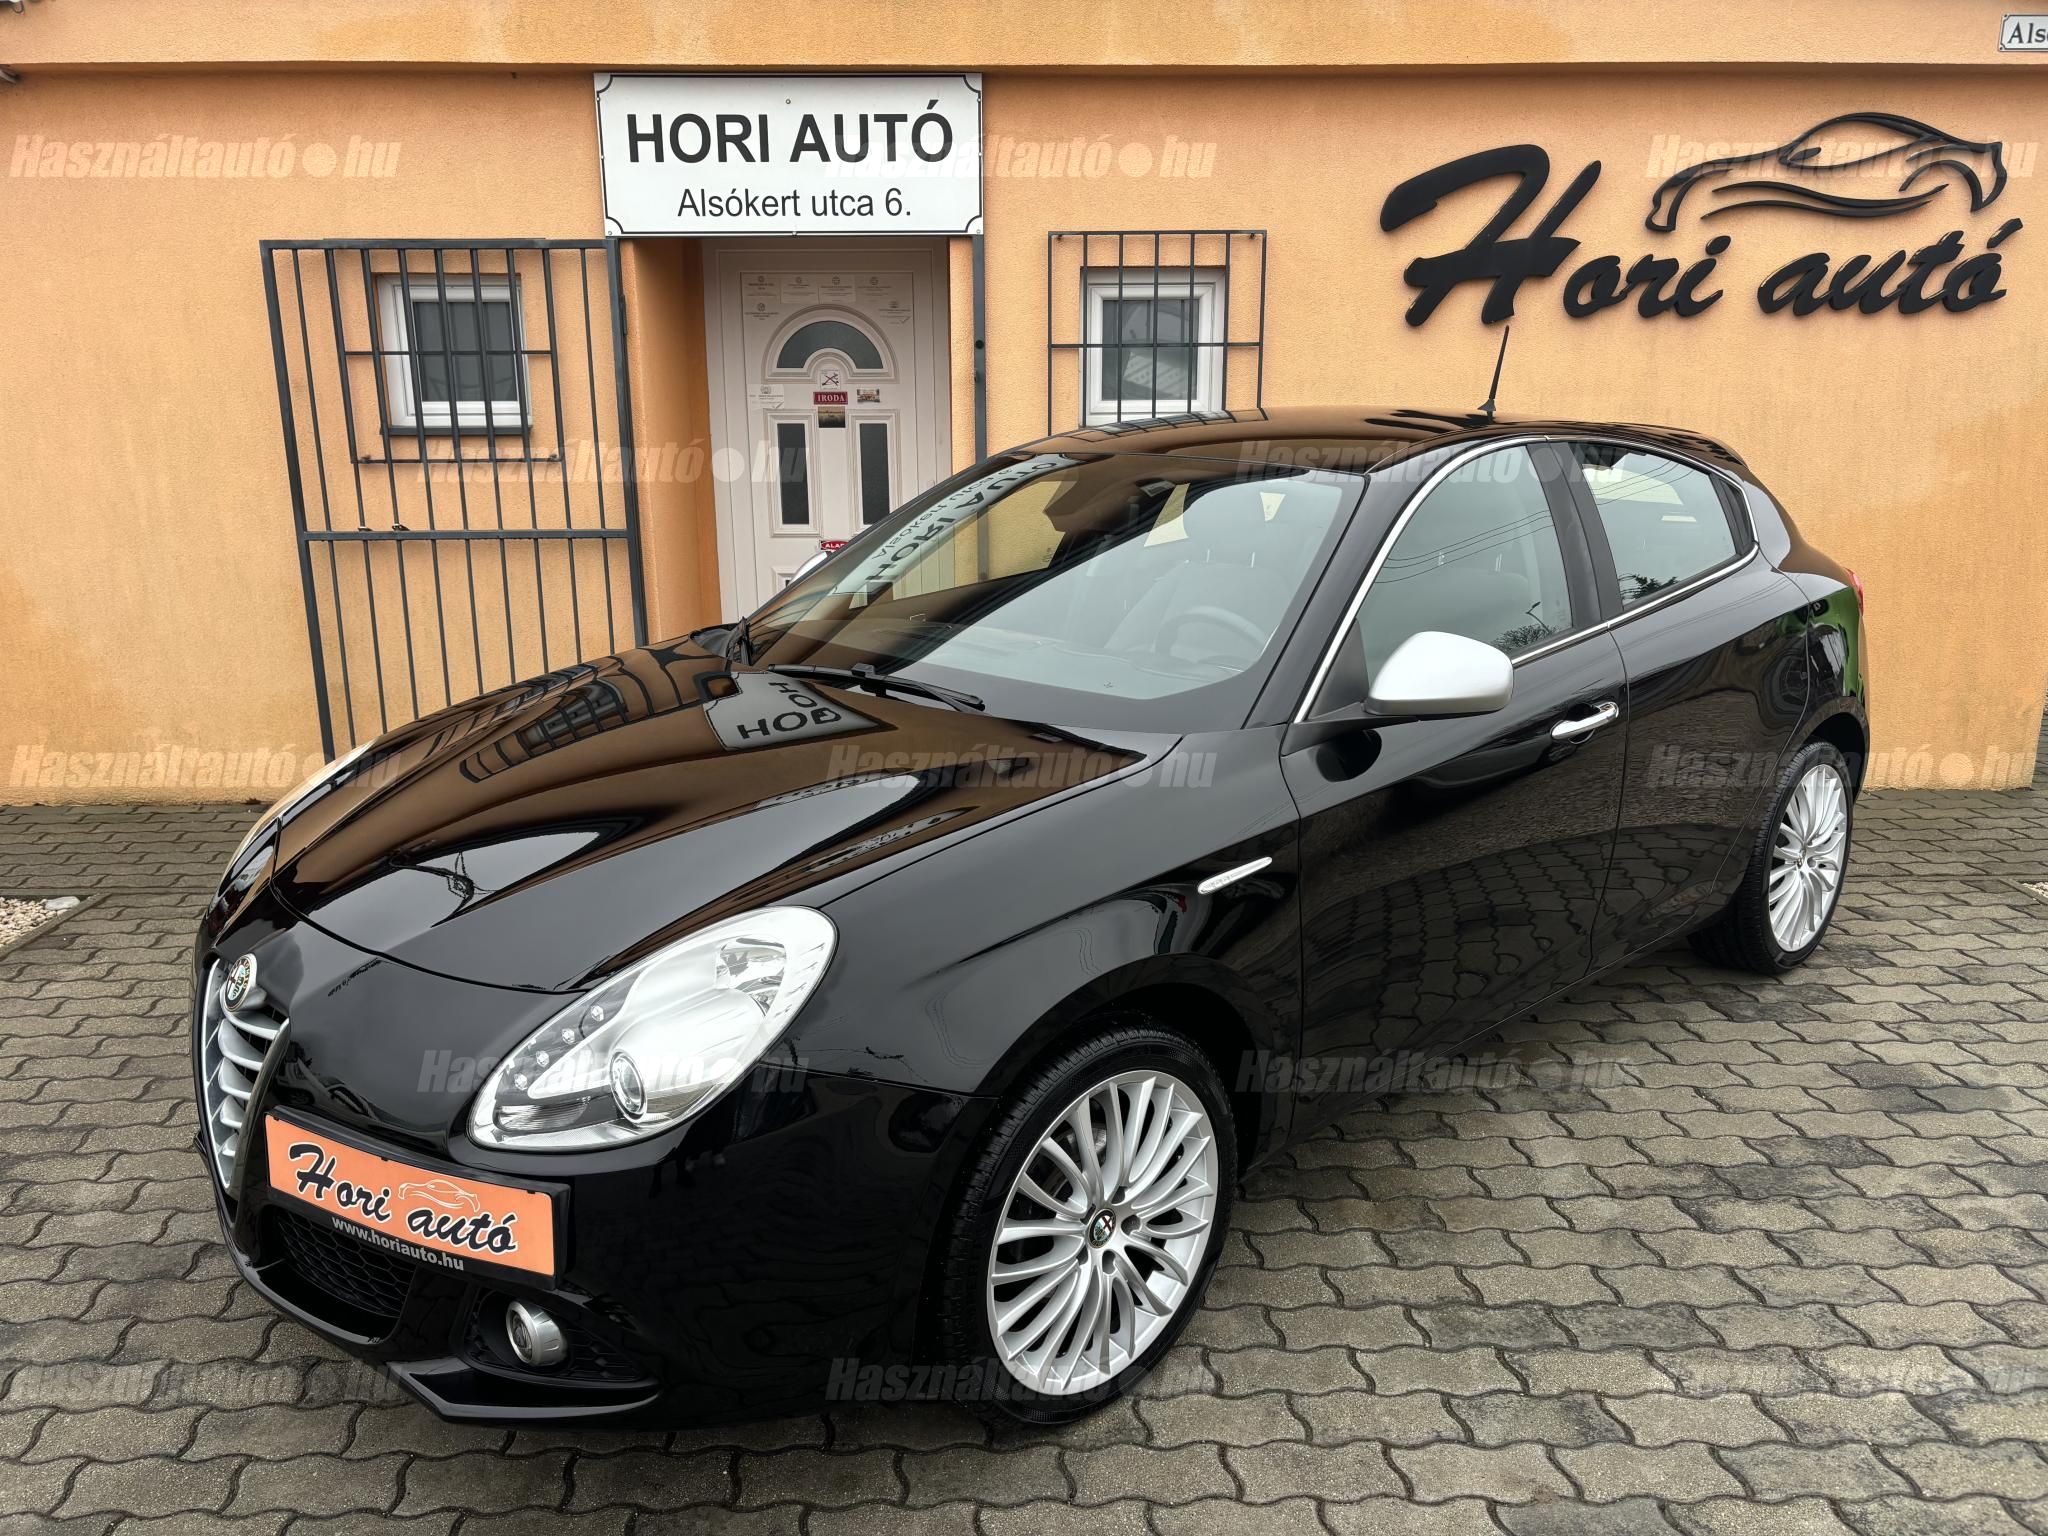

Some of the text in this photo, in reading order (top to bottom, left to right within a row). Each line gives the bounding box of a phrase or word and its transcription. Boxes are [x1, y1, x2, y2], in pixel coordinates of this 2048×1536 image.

[2007, 21, 2048, 44] Als
[626, 99, 953, 164] HORI AUTÓ
[677, 187, 912, 217] Alsókert utca 6.
[1379, 143, 2024, 327] Hori autó
[817, 394, 845, 402] IRODA
[288, 1142, 518, 1255] Hori autó
[331, 1215, 464, 1271] www.horiauto.hu
